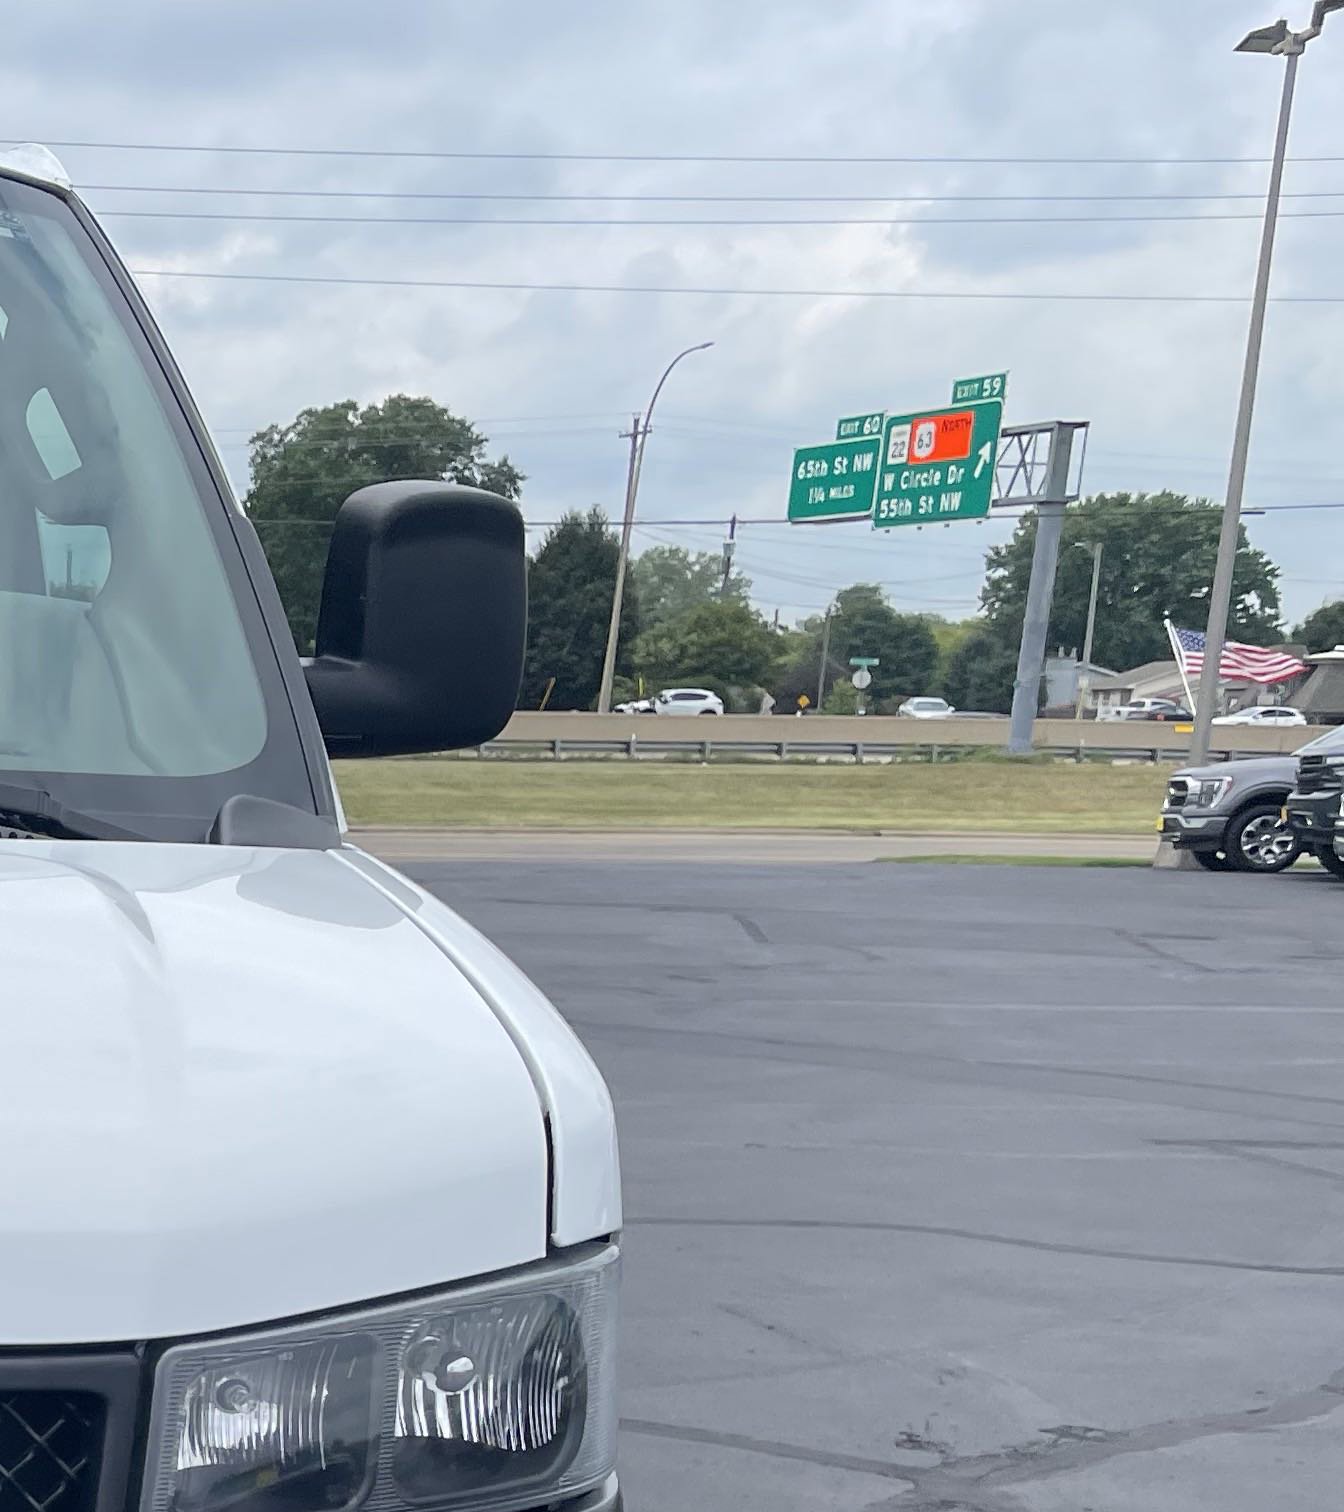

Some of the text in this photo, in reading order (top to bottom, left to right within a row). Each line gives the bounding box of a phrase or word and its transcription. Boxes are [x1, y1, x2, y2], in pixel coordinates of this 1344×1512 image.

[982, 376, 1002, 397] 59
[863, 415, 881, 435] 60
[892, 441, 907, 458] 22
[797, 452, 873, 480] 65th St NW
[884, 464, 965, 492] W Circle Dr
[879, 491, 962, 519] 55th St NW
